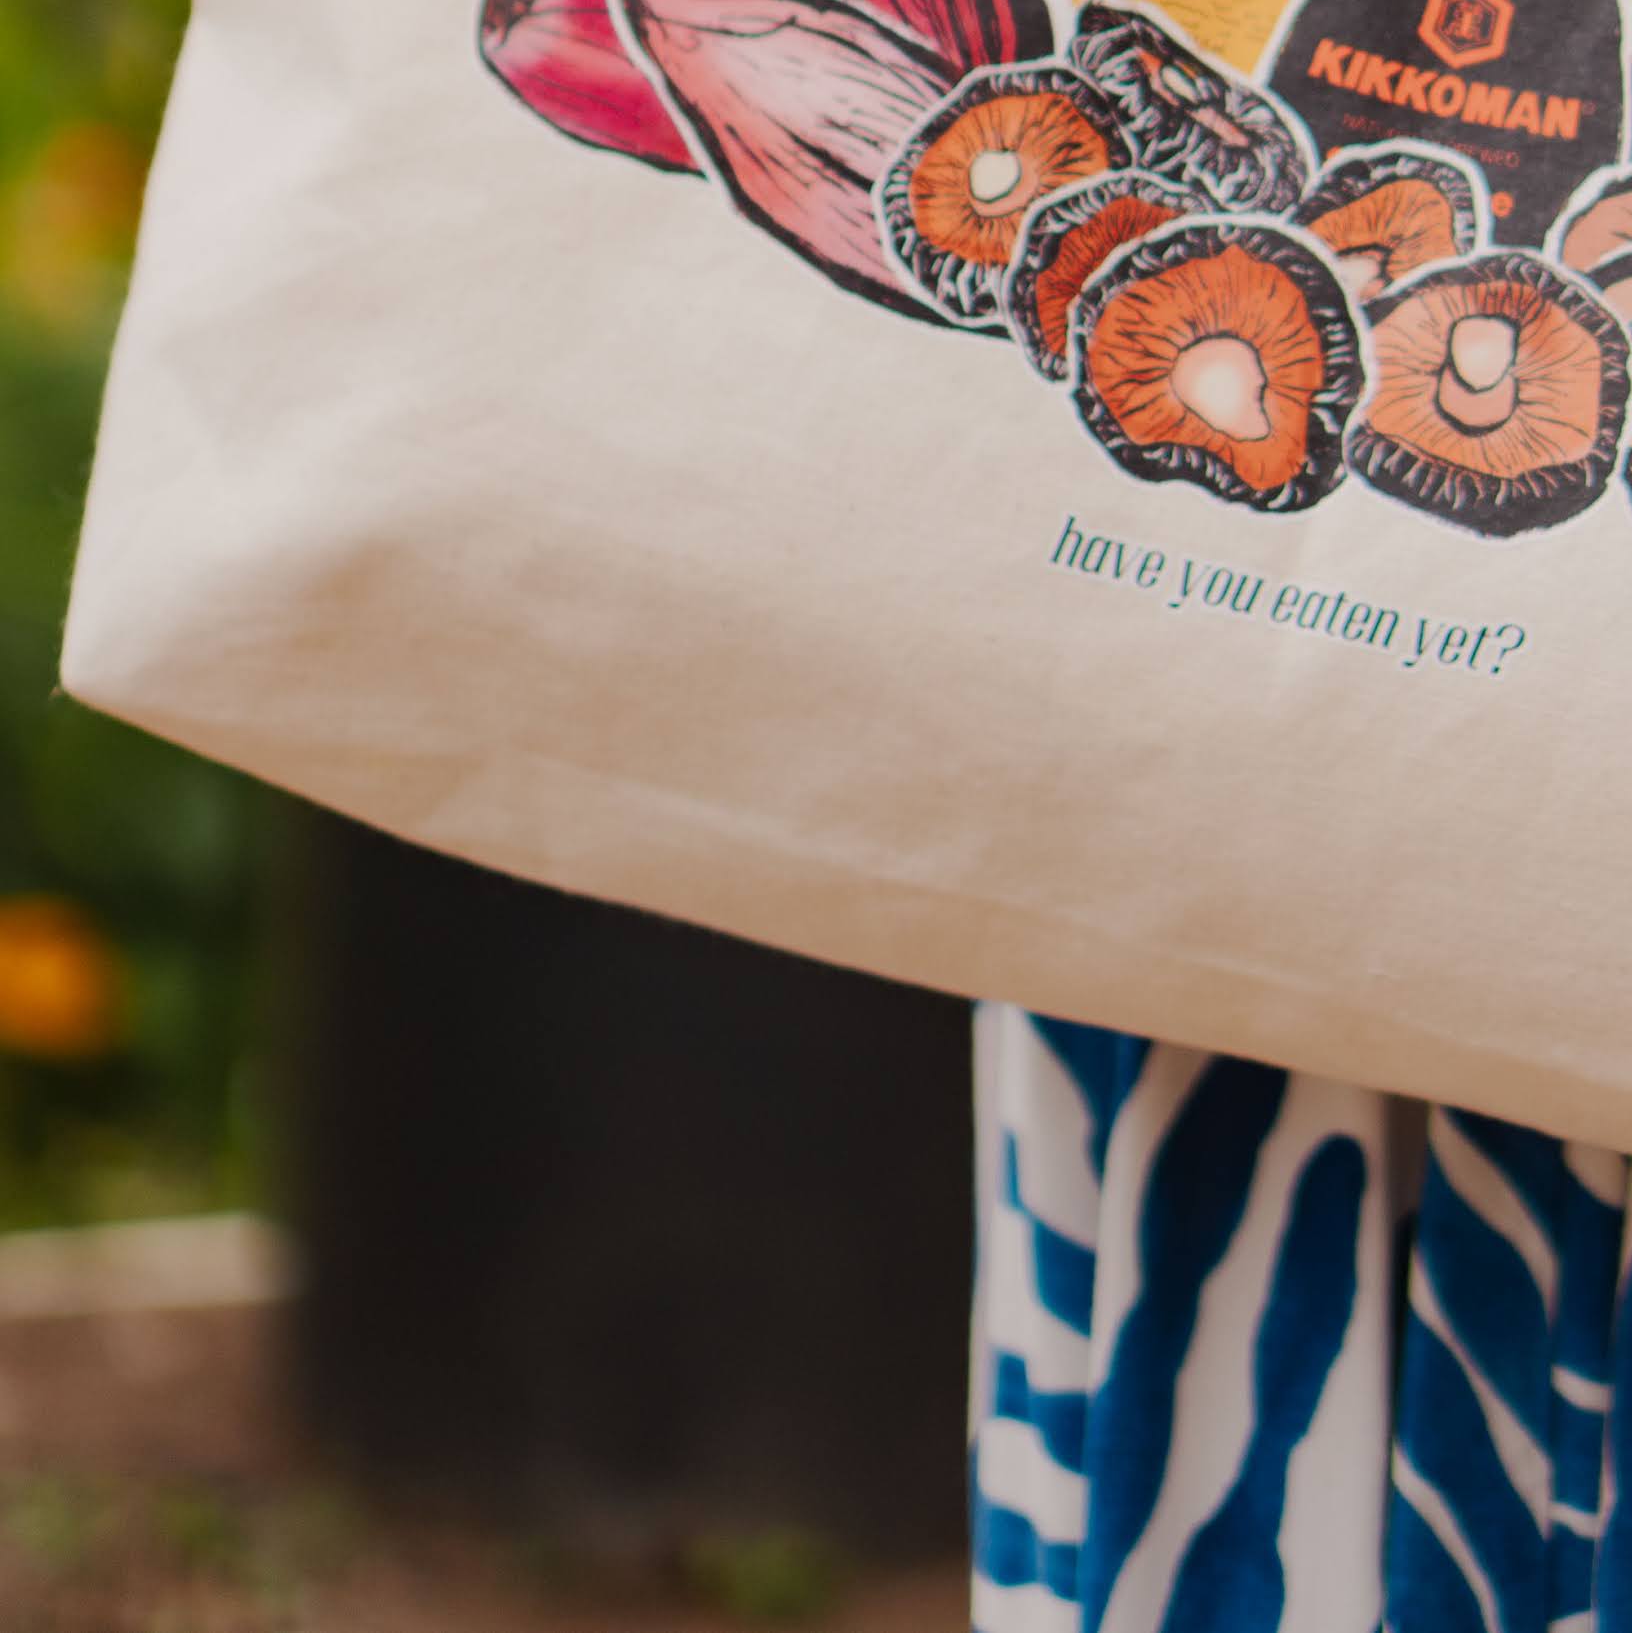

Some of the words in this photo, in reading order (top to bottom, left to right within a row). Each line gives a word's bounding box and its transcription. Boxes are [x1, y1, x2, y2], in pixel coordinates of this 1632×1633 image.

[1307, 37, 1582, 141] KIKKOMAN
[1049, 515, 1166, 588] have
[1168, 559, 1265, 613] you
[1270, 583, 1400, 648] eaten
[1402, 616, 1526, 675] yet?
